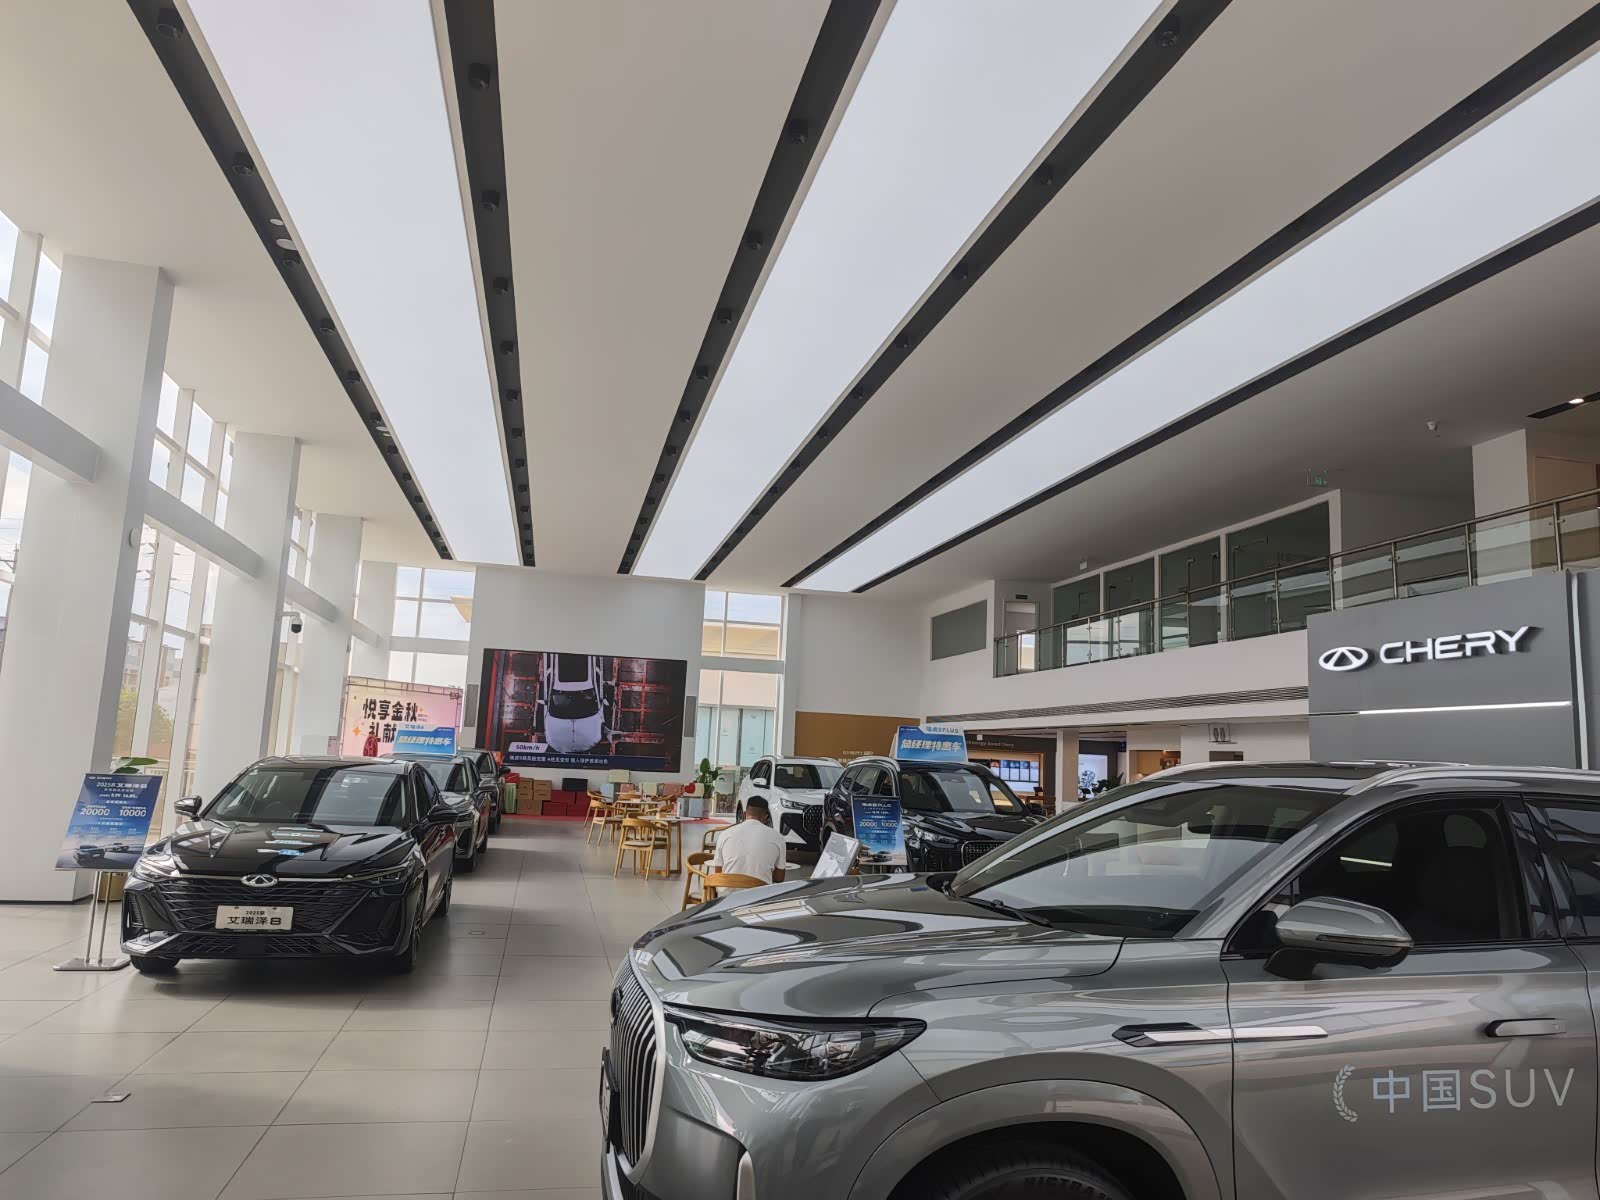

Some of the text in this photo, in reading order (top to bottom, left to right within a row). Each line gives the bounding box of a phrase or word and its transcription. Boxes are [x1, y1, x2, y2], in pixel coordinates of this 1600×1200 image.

[1379, 626, 1530, 664] CHERY
[363, 698, 418, 722] 悦享金秋
[901, 739, 962, 752] 总经理特惠车
[80, 808, 147, 817] 20000 10000
[227, 916, 281, 925] 艾瑞泽8
[1373, 1068, 1575, 1114] 中国SUV
